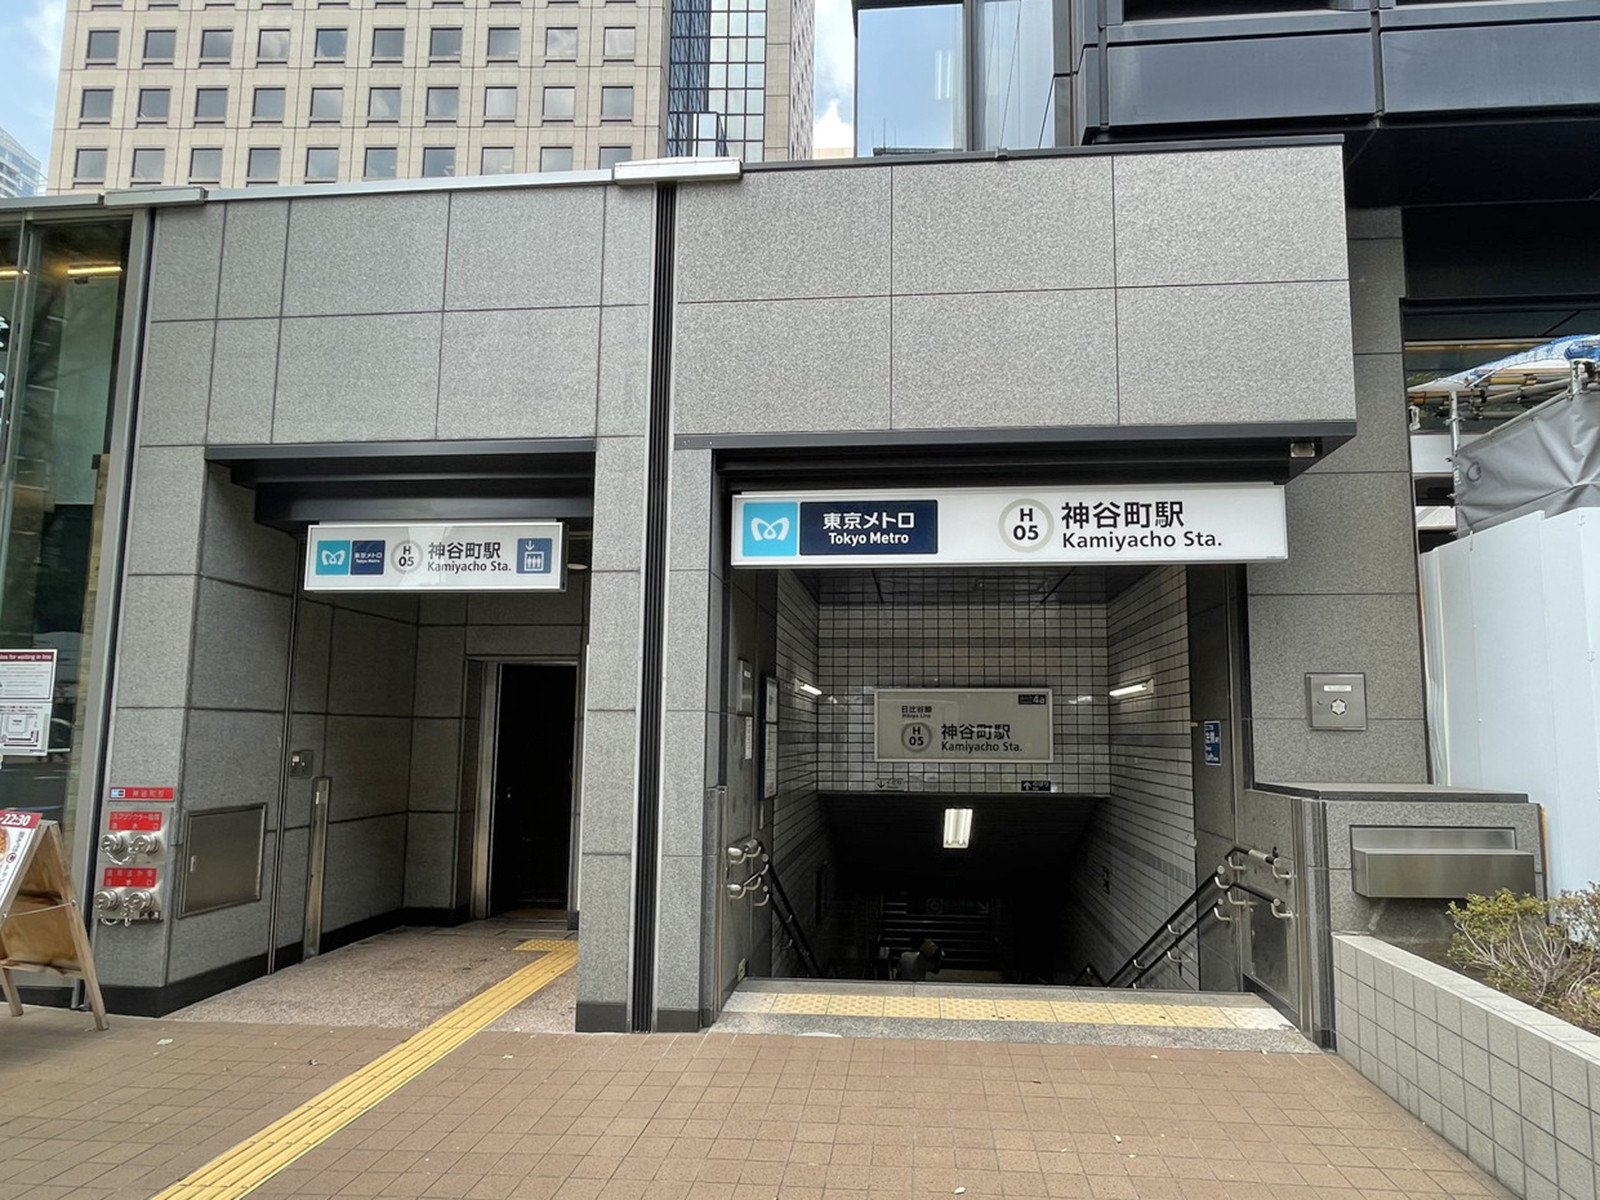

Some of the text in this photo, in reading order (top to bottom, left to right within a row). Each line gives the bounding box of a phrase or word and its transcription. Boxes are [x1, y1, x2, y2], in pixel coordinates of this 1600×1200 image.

[822, 511, 916, 531] 東京メトロ
[1019, 508, 1034, 523] H
[1061, 501, 1185, 529] 神谷町駅
[828, 531, 910, 547] Tokyo Metro
[1012, 524, 1040, 541] 05
[1062, 530, 1223, 553] Kamiyacho Sta.
[402, 545, 412, 556] H
[428, 542, 501, 560] 神谷町駅
[398, 557, 415, 567] 05
[427, 560, 512, 574] Kamiyacho Sta.
[901, 705, 932, 714] 日比谷線
[912, 726, 921, 735] H
[941, 723, 1011, 740] 神谷町駅
[908, 736, 925, 747] 05
[941, 742, 1023, 754] Kamiyacho Sta.
